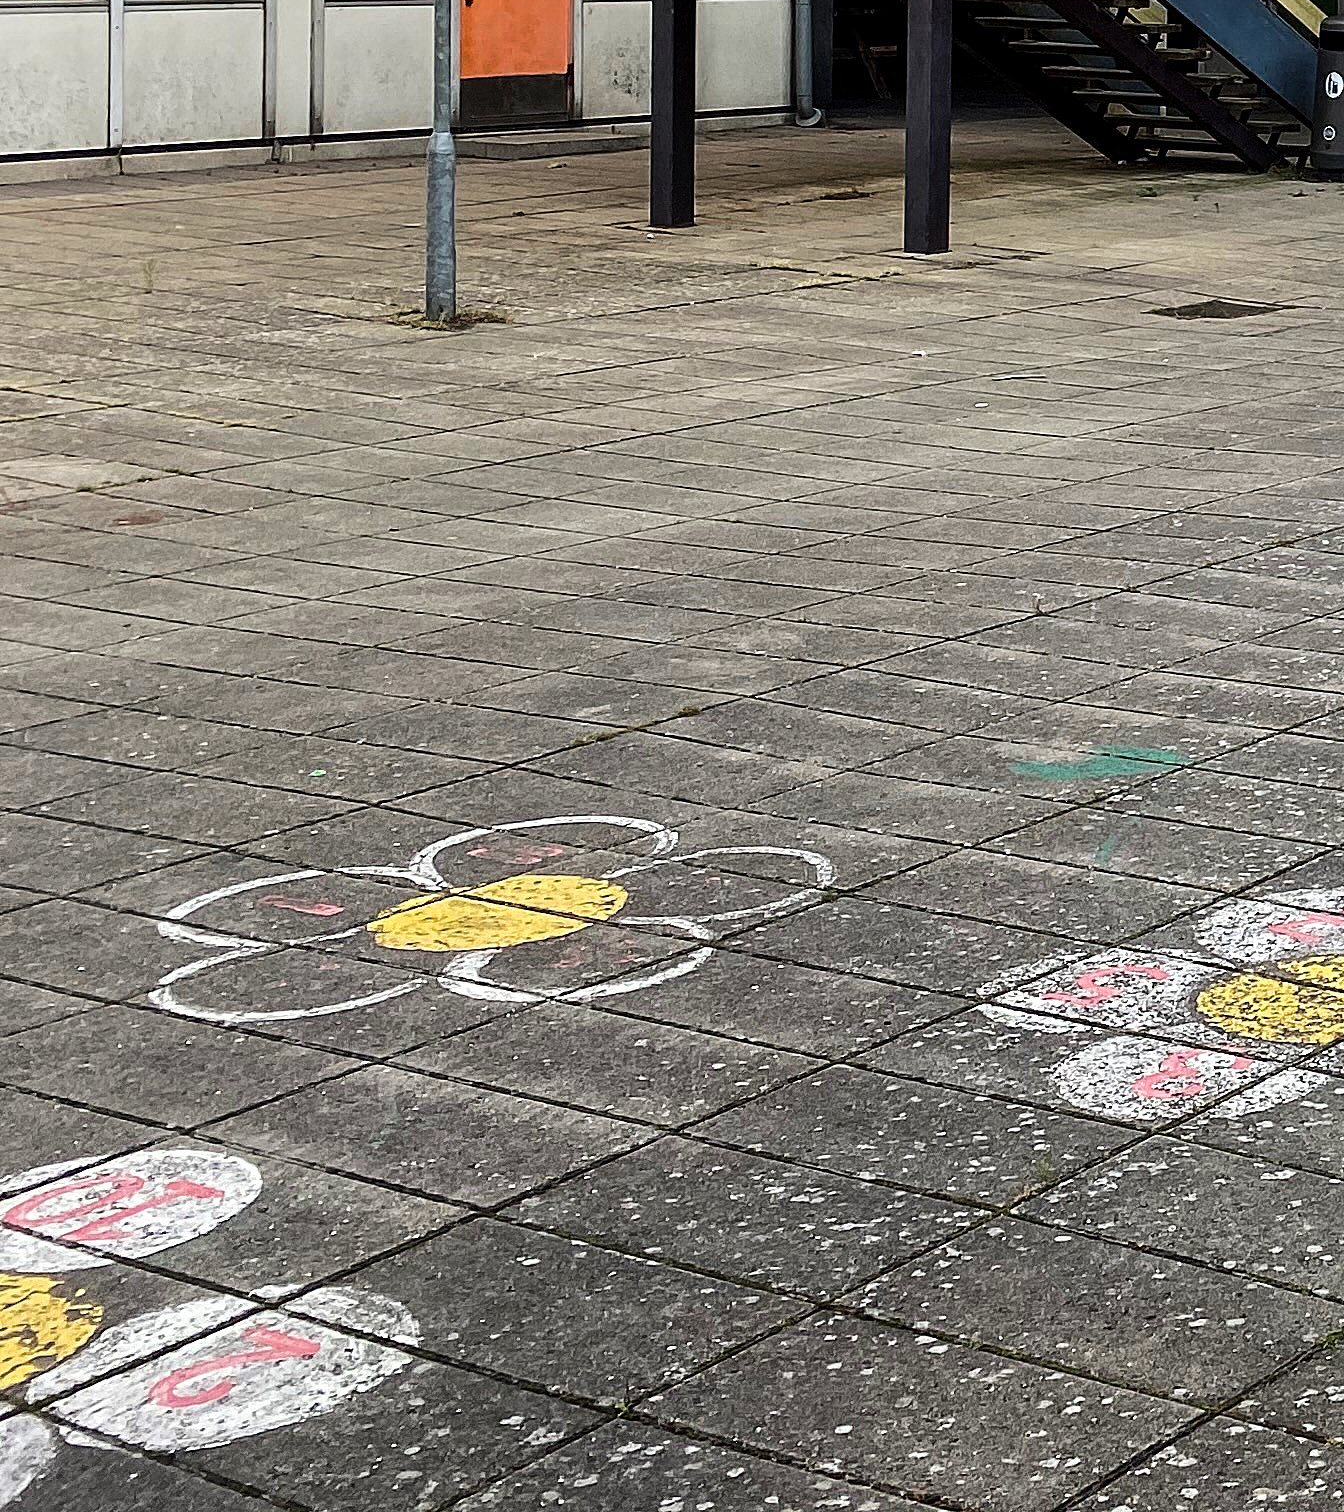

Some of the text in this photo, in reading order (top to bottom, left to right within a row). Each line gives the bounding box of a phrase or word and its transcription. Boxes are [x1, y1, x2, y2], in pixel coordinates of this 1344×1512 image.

[1041, 964, 1170, 1007] 5
[2, 1174, 226, 1243] 10
[148, 1325, 322, 1409] 2
